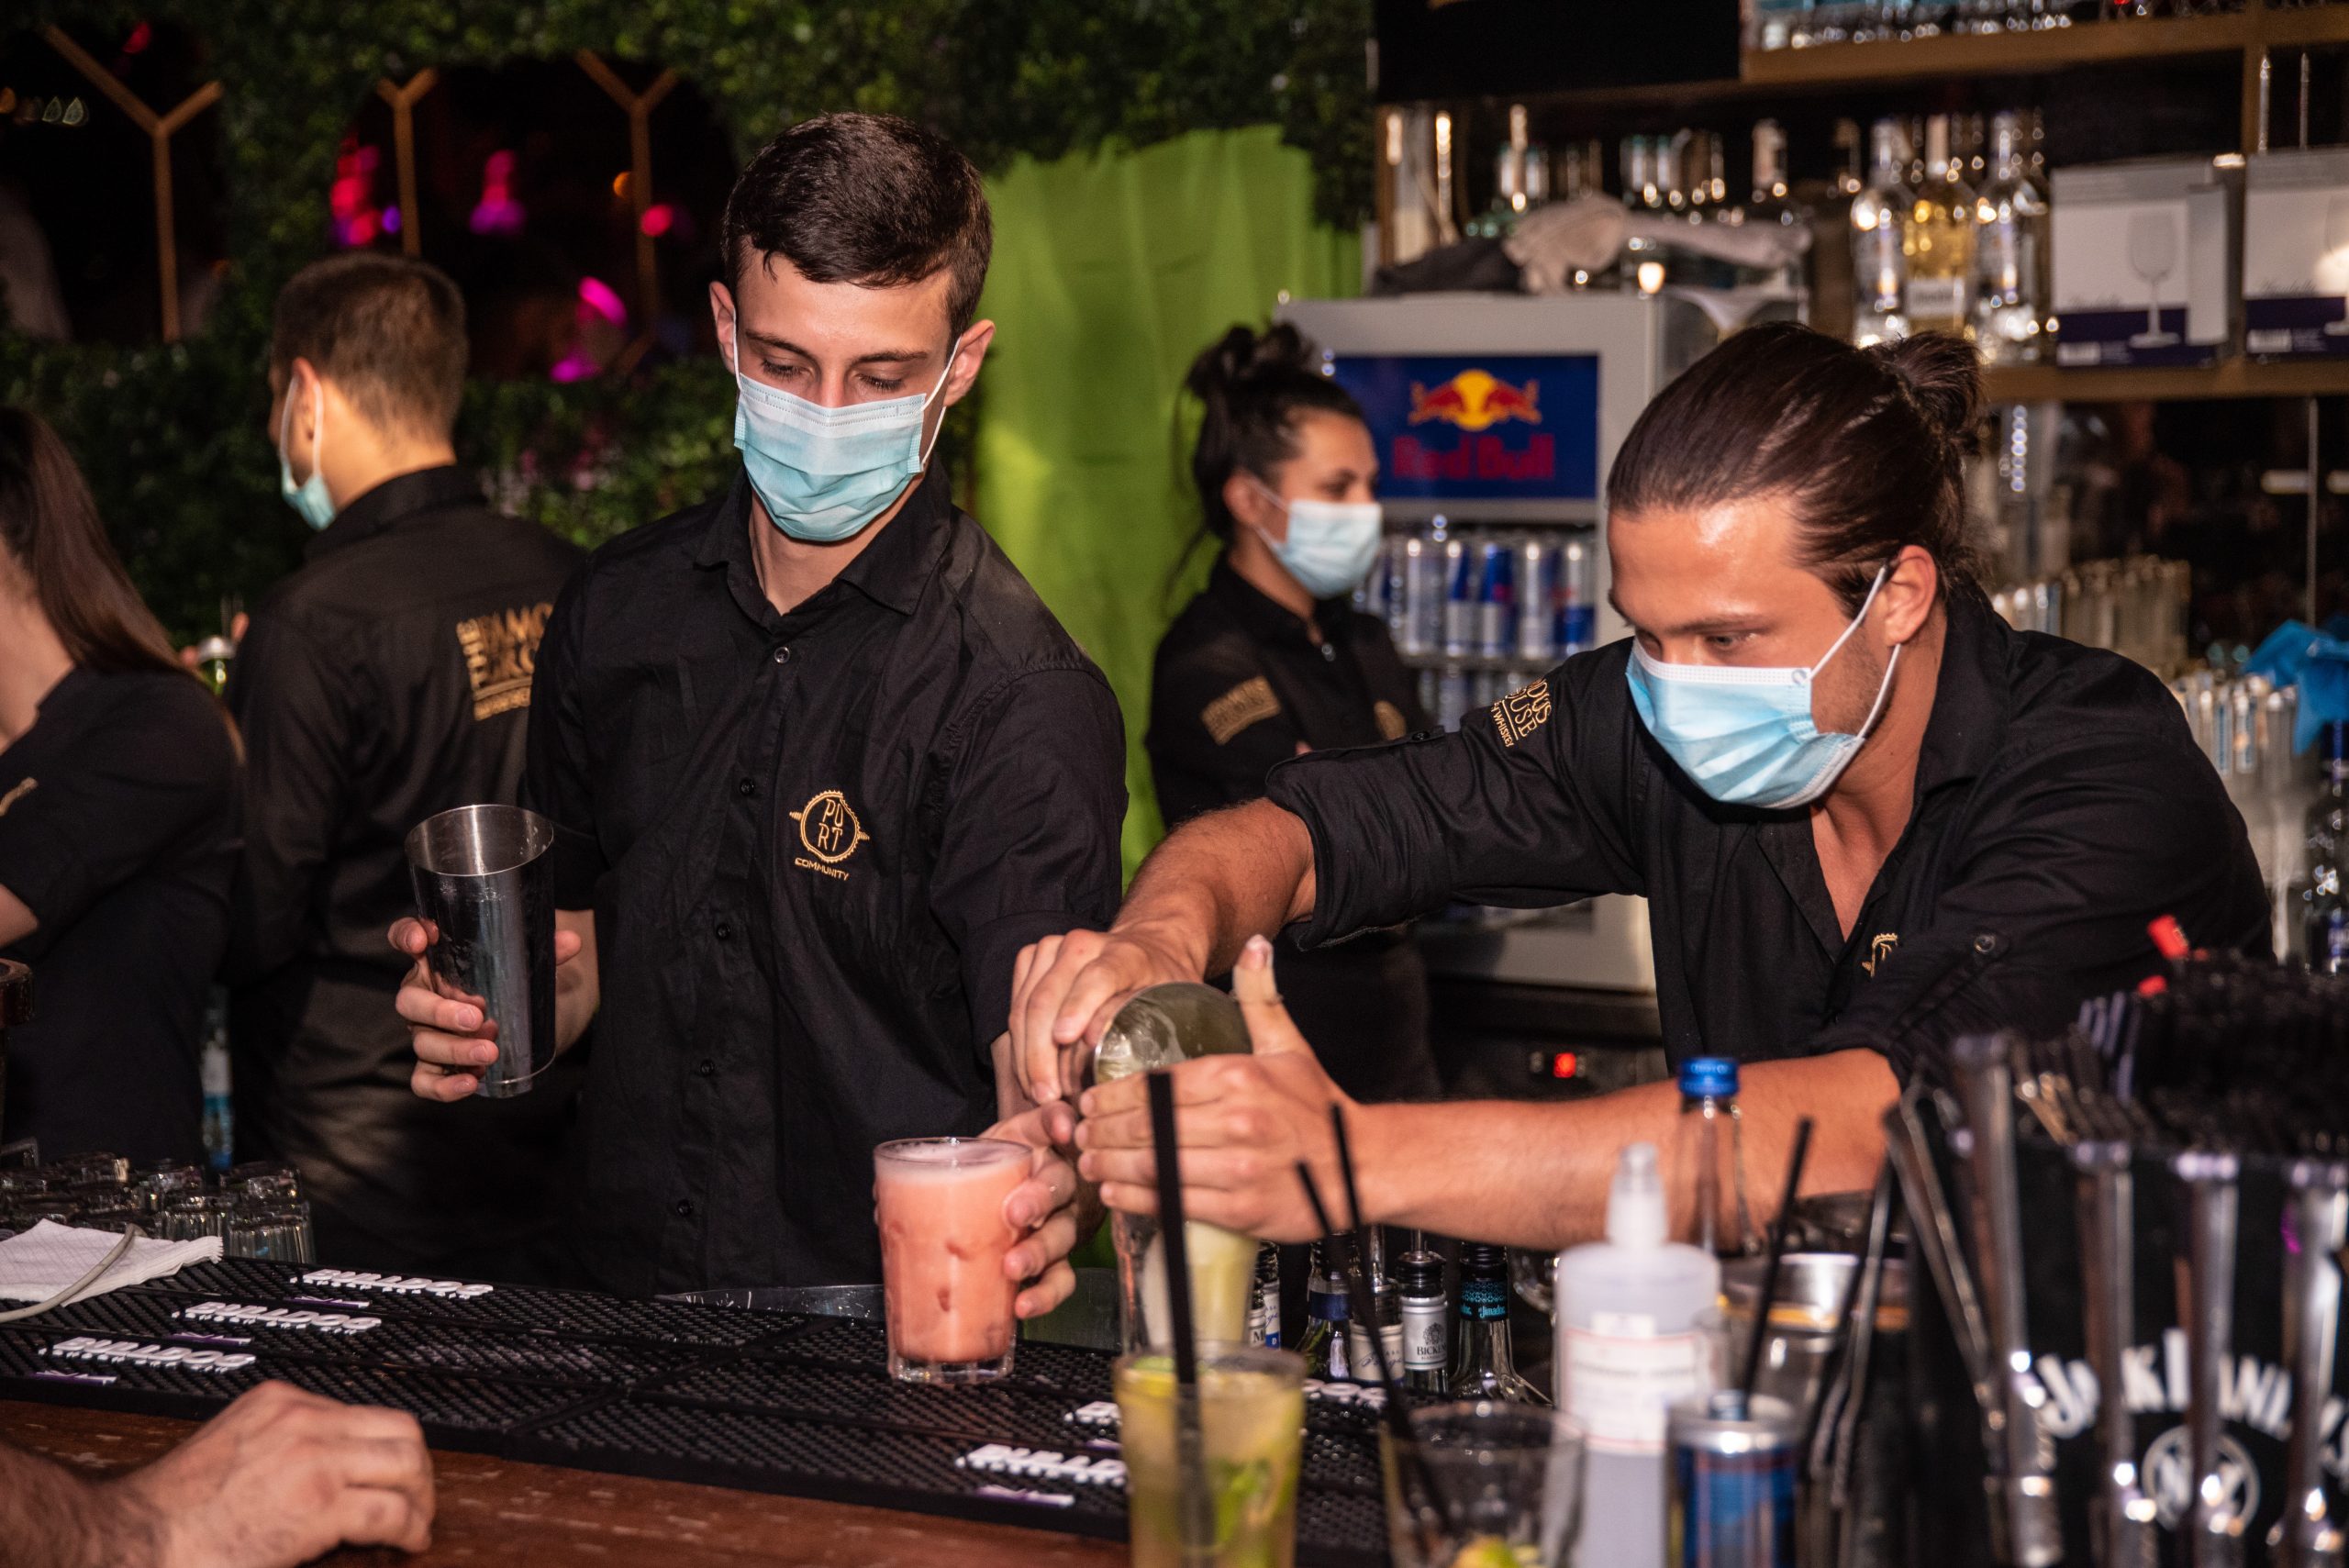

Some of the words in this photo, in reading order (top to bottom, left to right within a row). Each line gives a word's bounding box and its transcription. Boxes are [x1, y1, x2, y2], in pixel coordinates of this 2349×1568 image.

[1394, 435, 1472, 480] Red
[1477, 434, 1554, 480] Bull
[795, 857, 850, 881] COMMUNITY
[303, 1269, 494, 1296] BULLDOG
[185, 1301, 383, 1329] BULLDOG
[53, 1337, 257, 1367] BULLDOG
